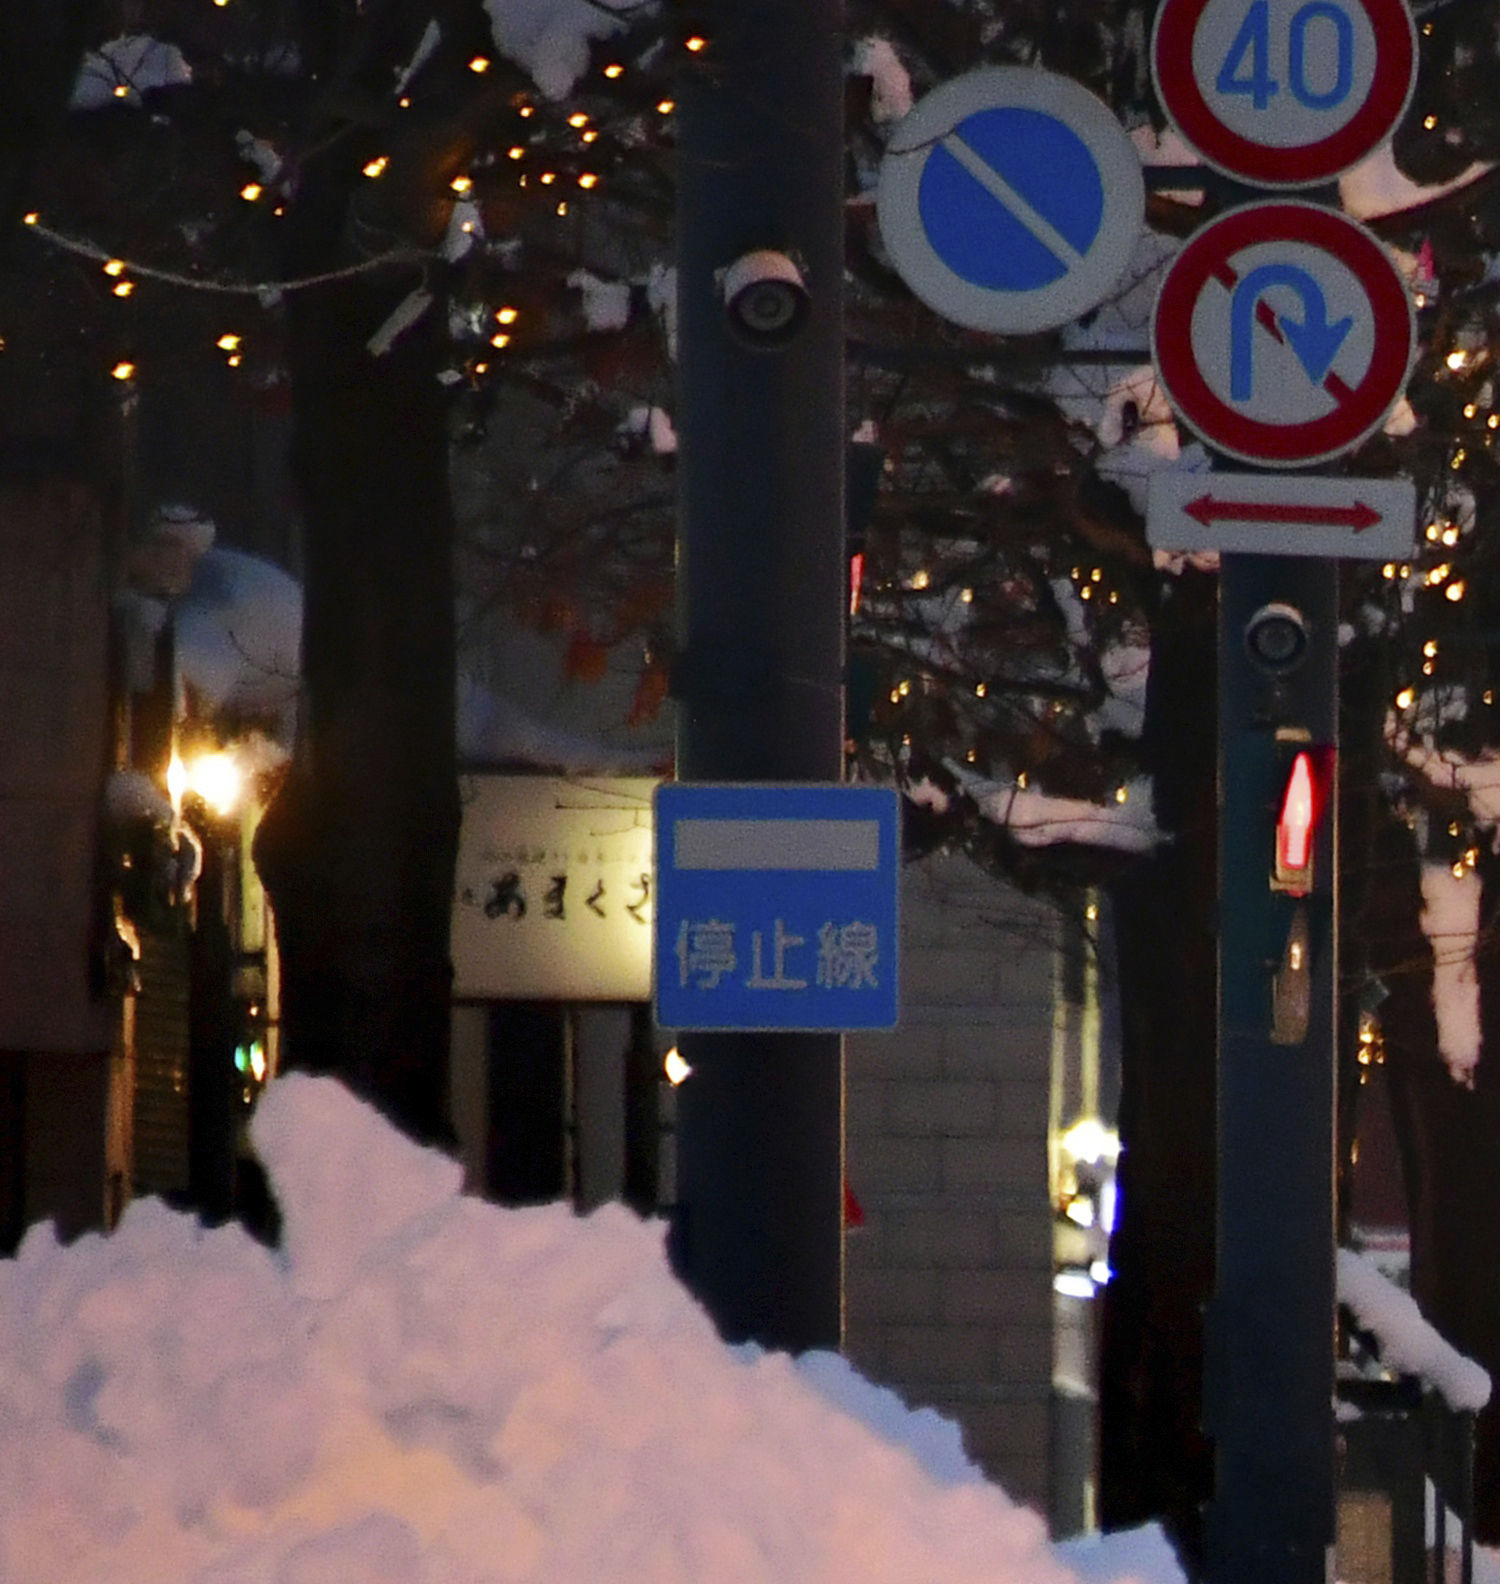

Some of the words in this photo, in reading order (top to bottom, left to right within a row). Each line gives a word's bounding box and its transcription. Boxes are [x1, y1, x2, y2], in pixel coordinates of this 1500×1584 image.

[1216, 0, 1353, 111] 40
[675, 919, 879, 989] 停止線
